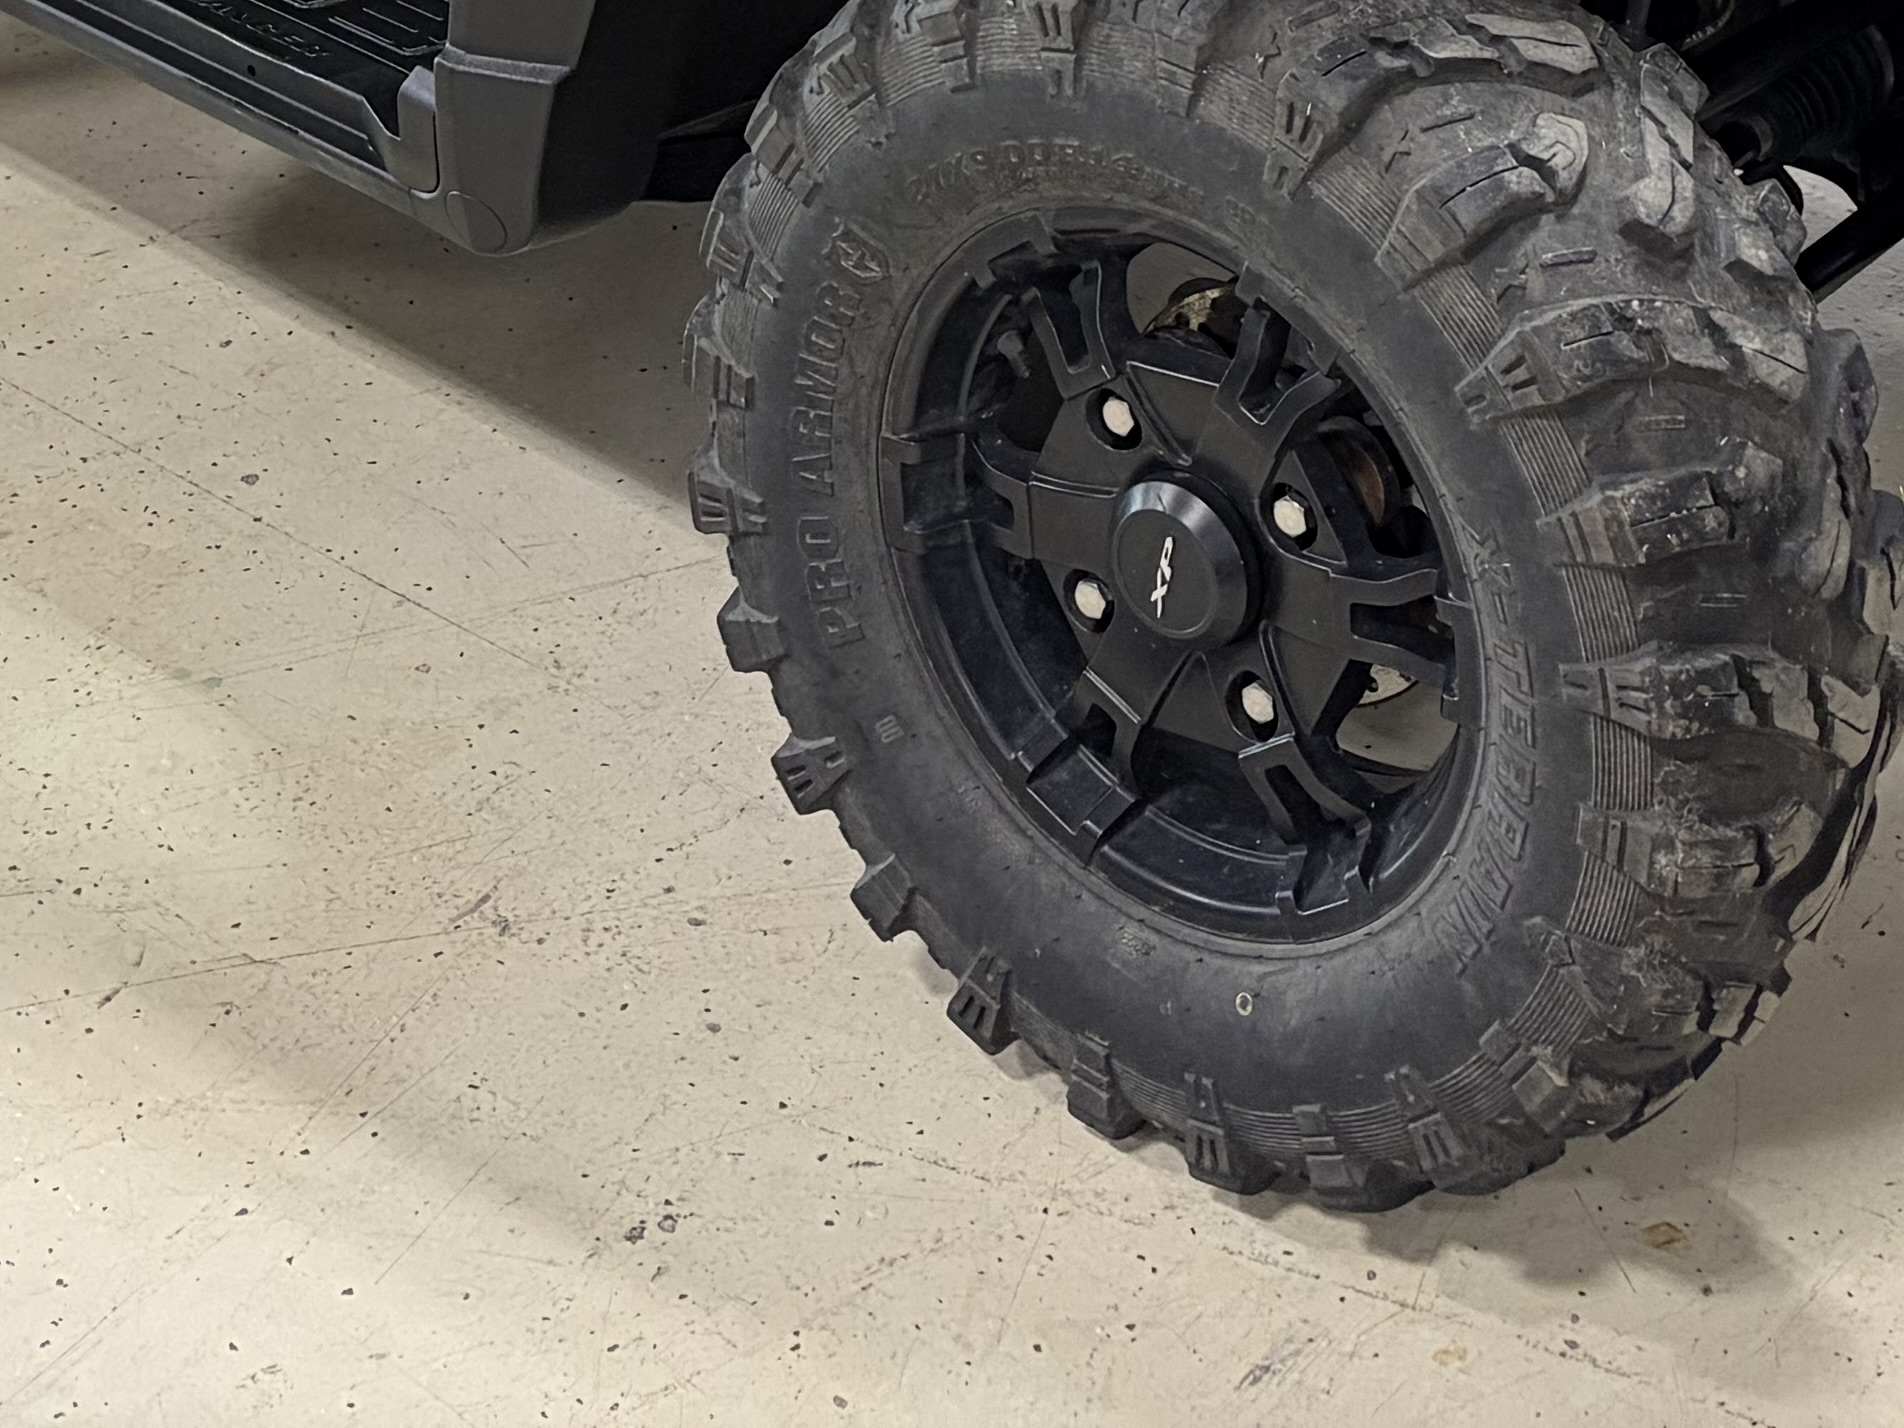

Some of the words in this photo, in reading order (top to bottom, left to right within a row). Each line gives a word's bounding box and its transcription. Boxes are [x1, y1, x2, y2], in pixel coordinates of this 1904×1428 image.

[792, 280, 863, 498] ARMOR
[798, 514, 865, 644] PRO
[1150, 536, 1174, 619] XP
[1432, 517, 1537, 977] X-TERRAIN
